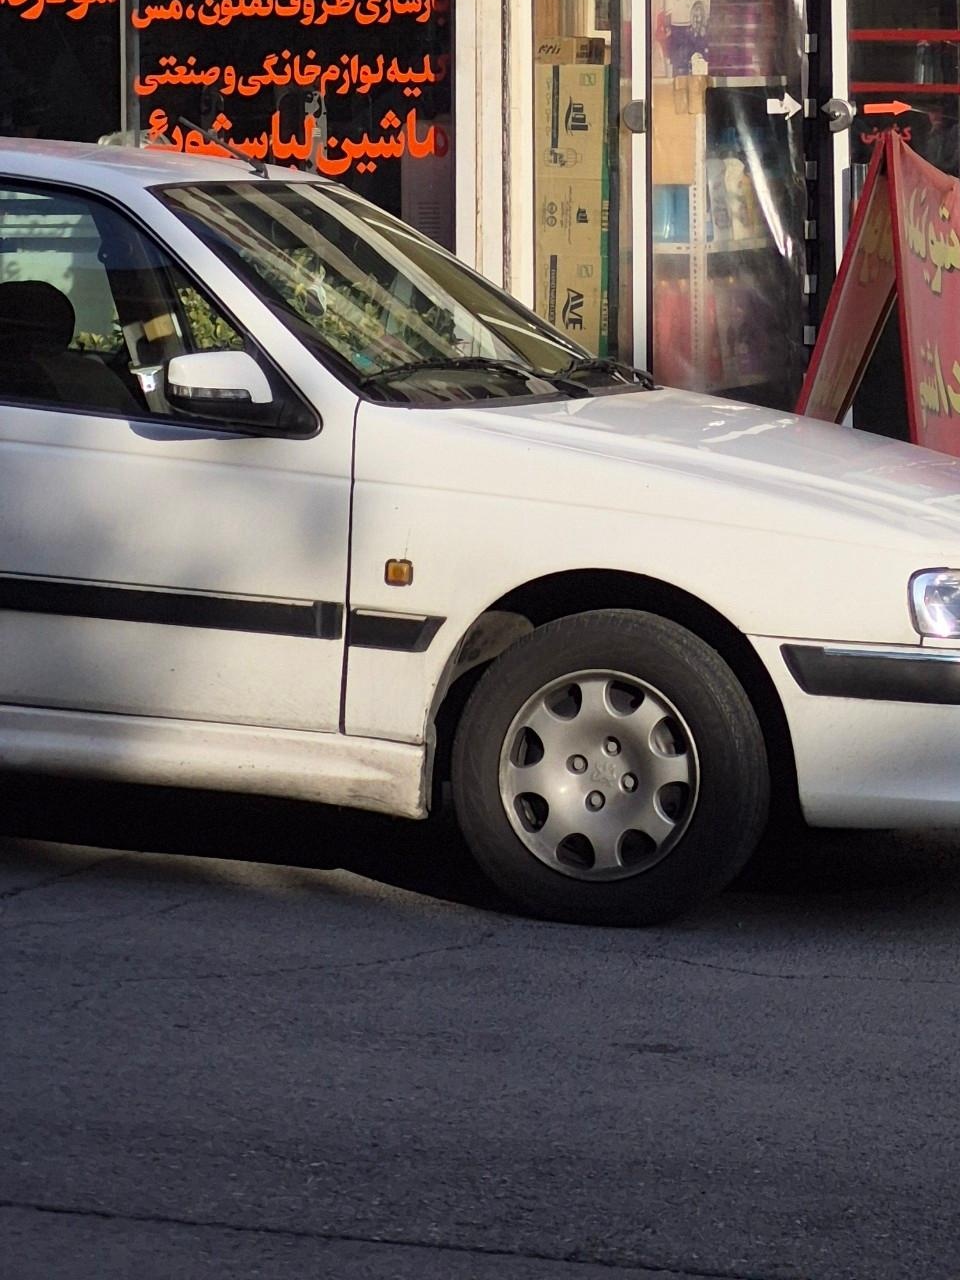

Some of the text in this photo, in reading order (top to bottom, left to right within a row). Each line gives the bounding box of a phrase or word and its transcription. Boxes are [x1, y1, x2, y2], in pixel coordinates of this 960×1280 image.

[132, 54, 222, 98] صنعتی
[238, 49, 321, 97] خانگی
[320, 54, 385, 96] لوازم
